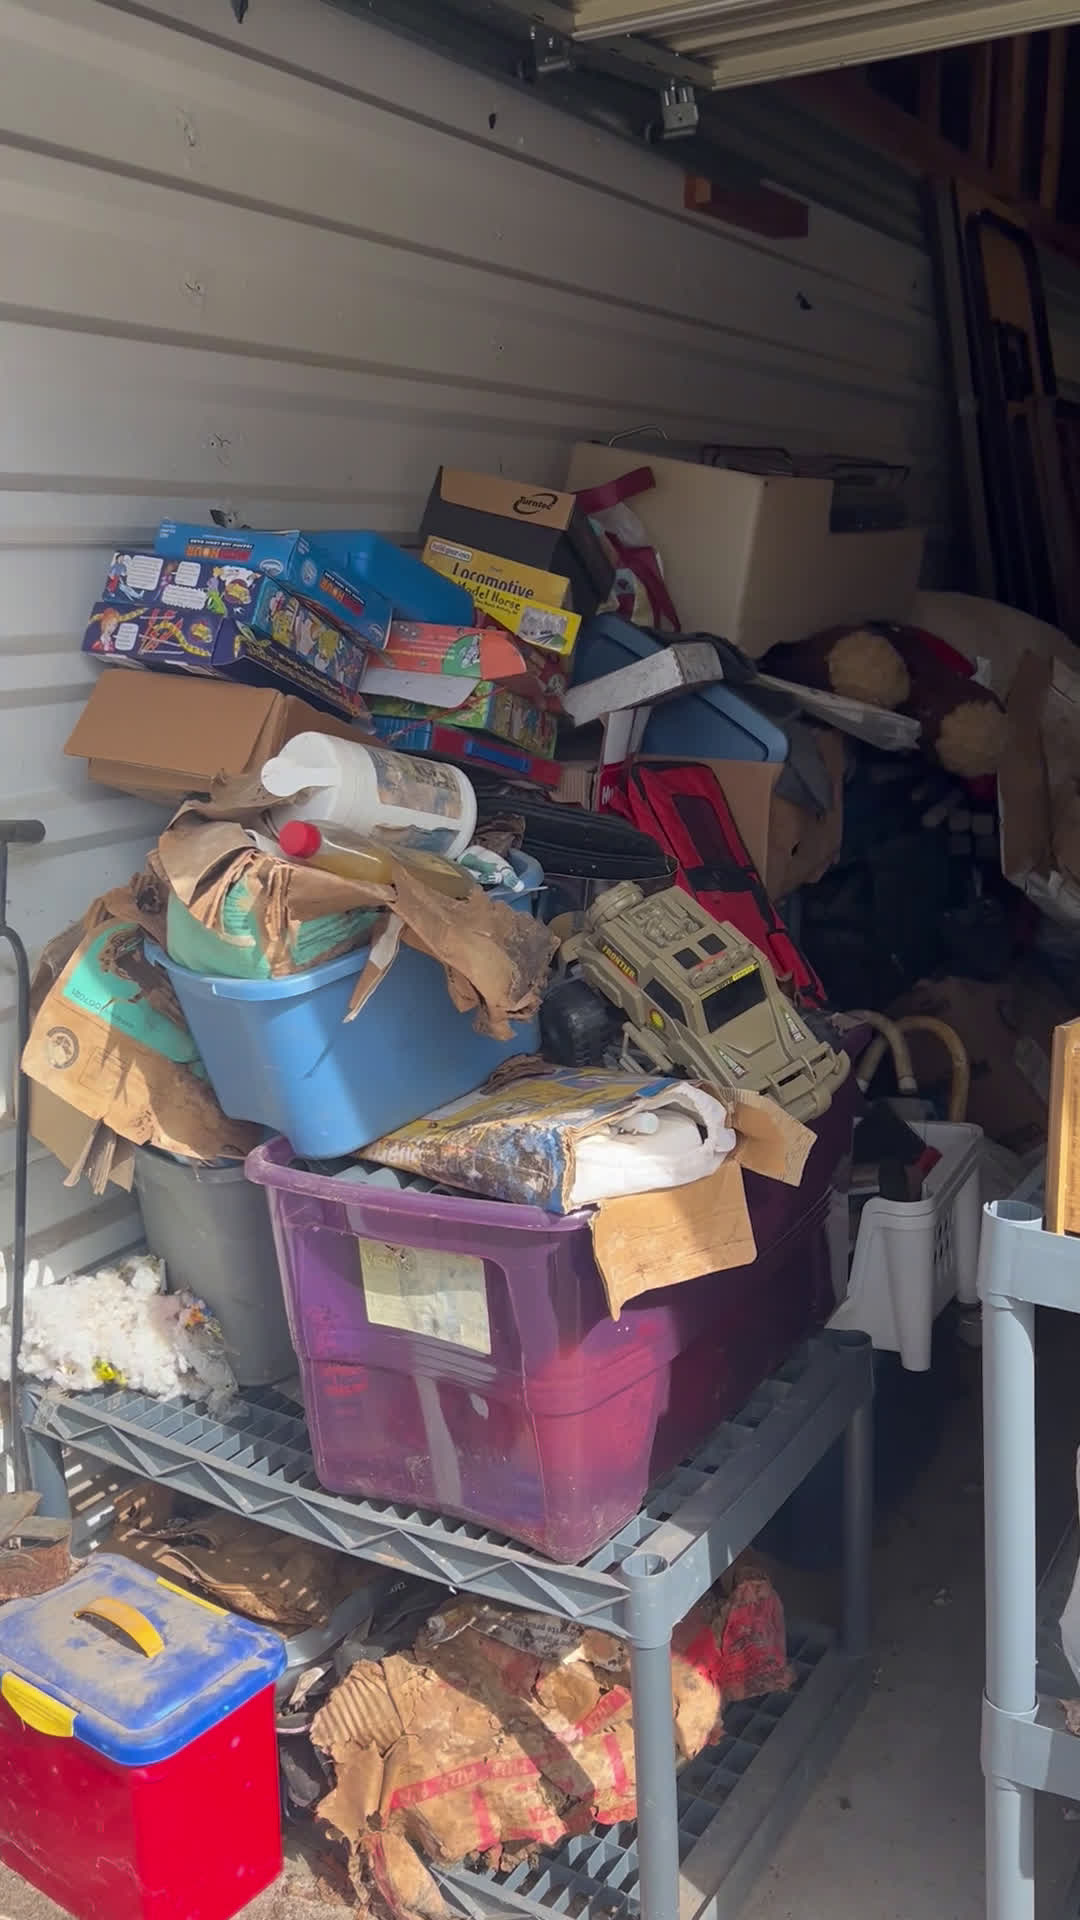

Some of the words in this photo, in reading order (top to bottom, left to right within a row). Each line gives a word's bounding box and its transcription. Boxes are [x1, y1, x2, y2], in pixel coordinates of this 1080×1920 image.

[520, 496, 553, 511] Turntec
[452, 562, 535, 598] Locomotive
[602, 944, 636, 978] FRONTIER
